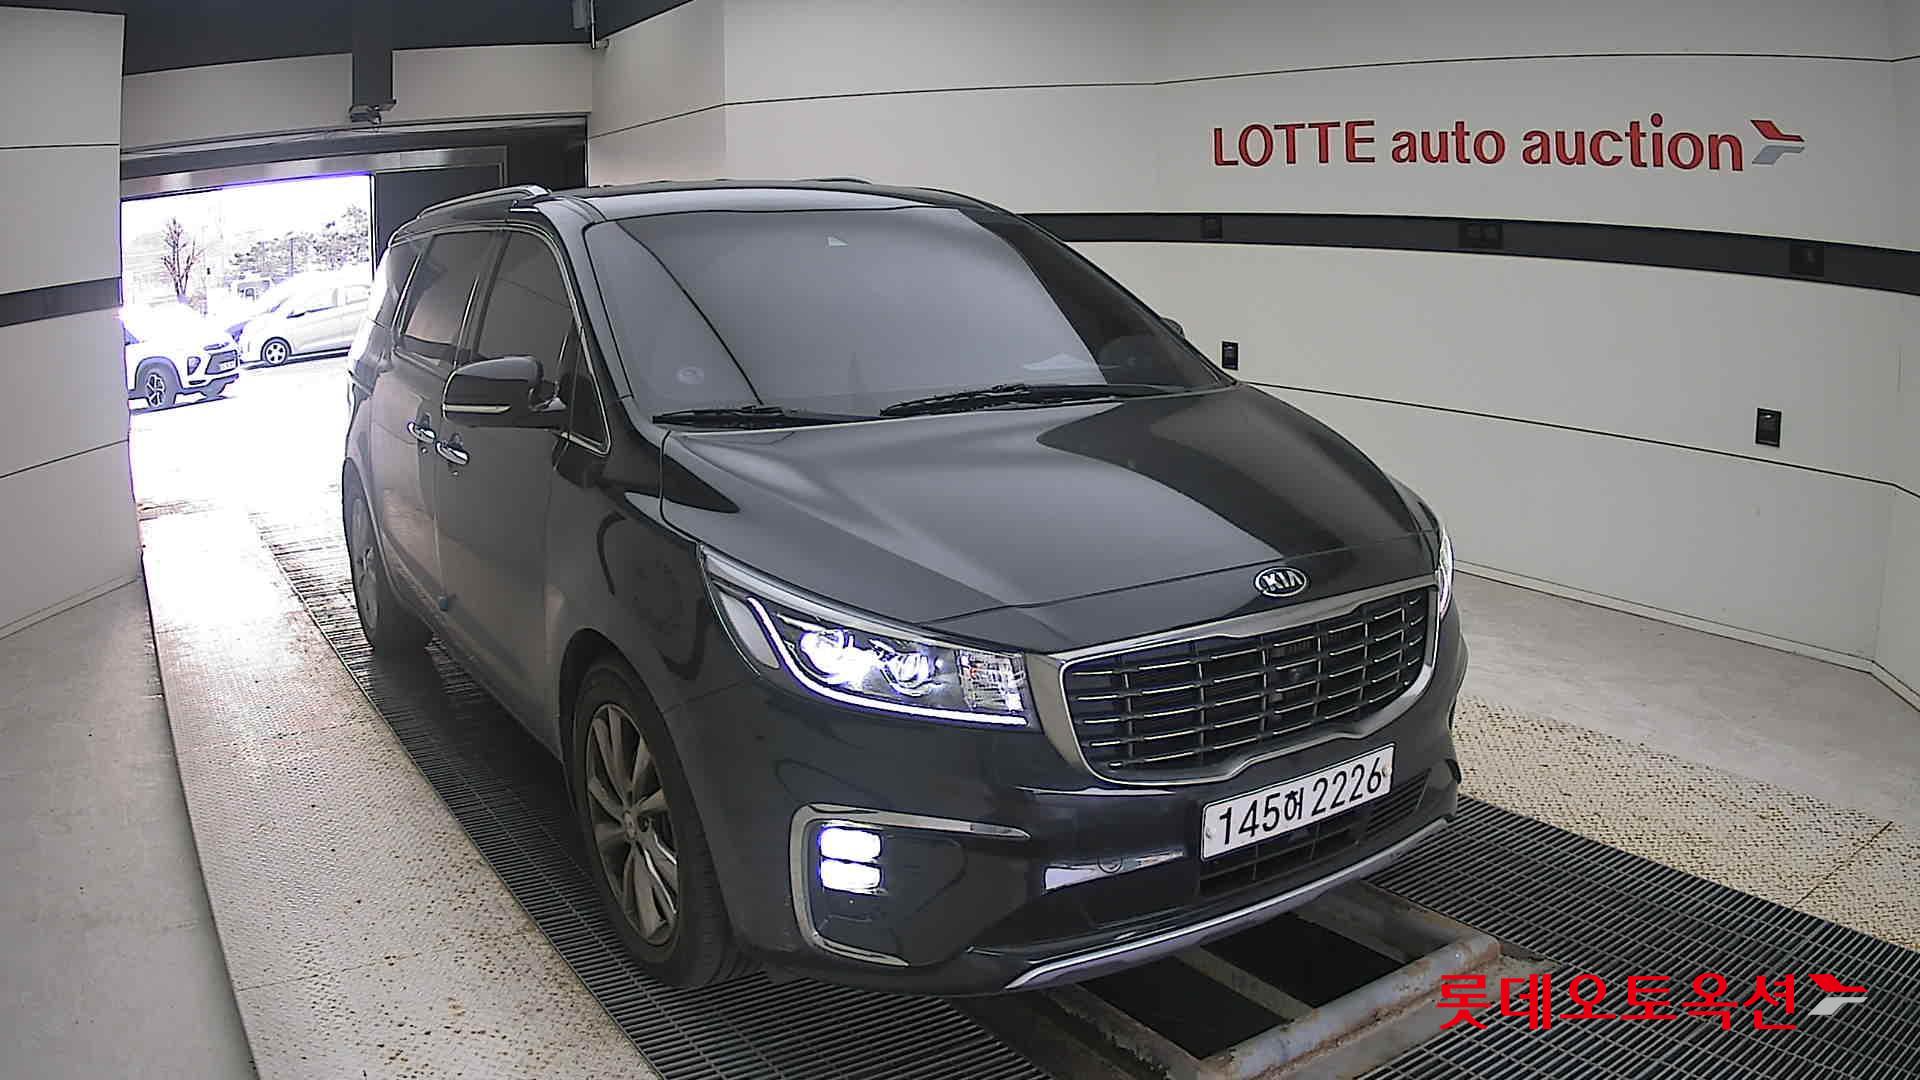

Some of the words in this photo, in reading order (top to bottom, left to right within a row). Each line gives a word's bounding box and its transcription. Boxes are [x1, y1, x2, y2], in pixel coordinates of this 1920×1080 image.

[1213, 119, 1376, 167] LOTTE
[1391, 121, 1507, 165] auto
[1521, 112, 1744, 172] auction
[1262, 570, 1303, 591] KIA
